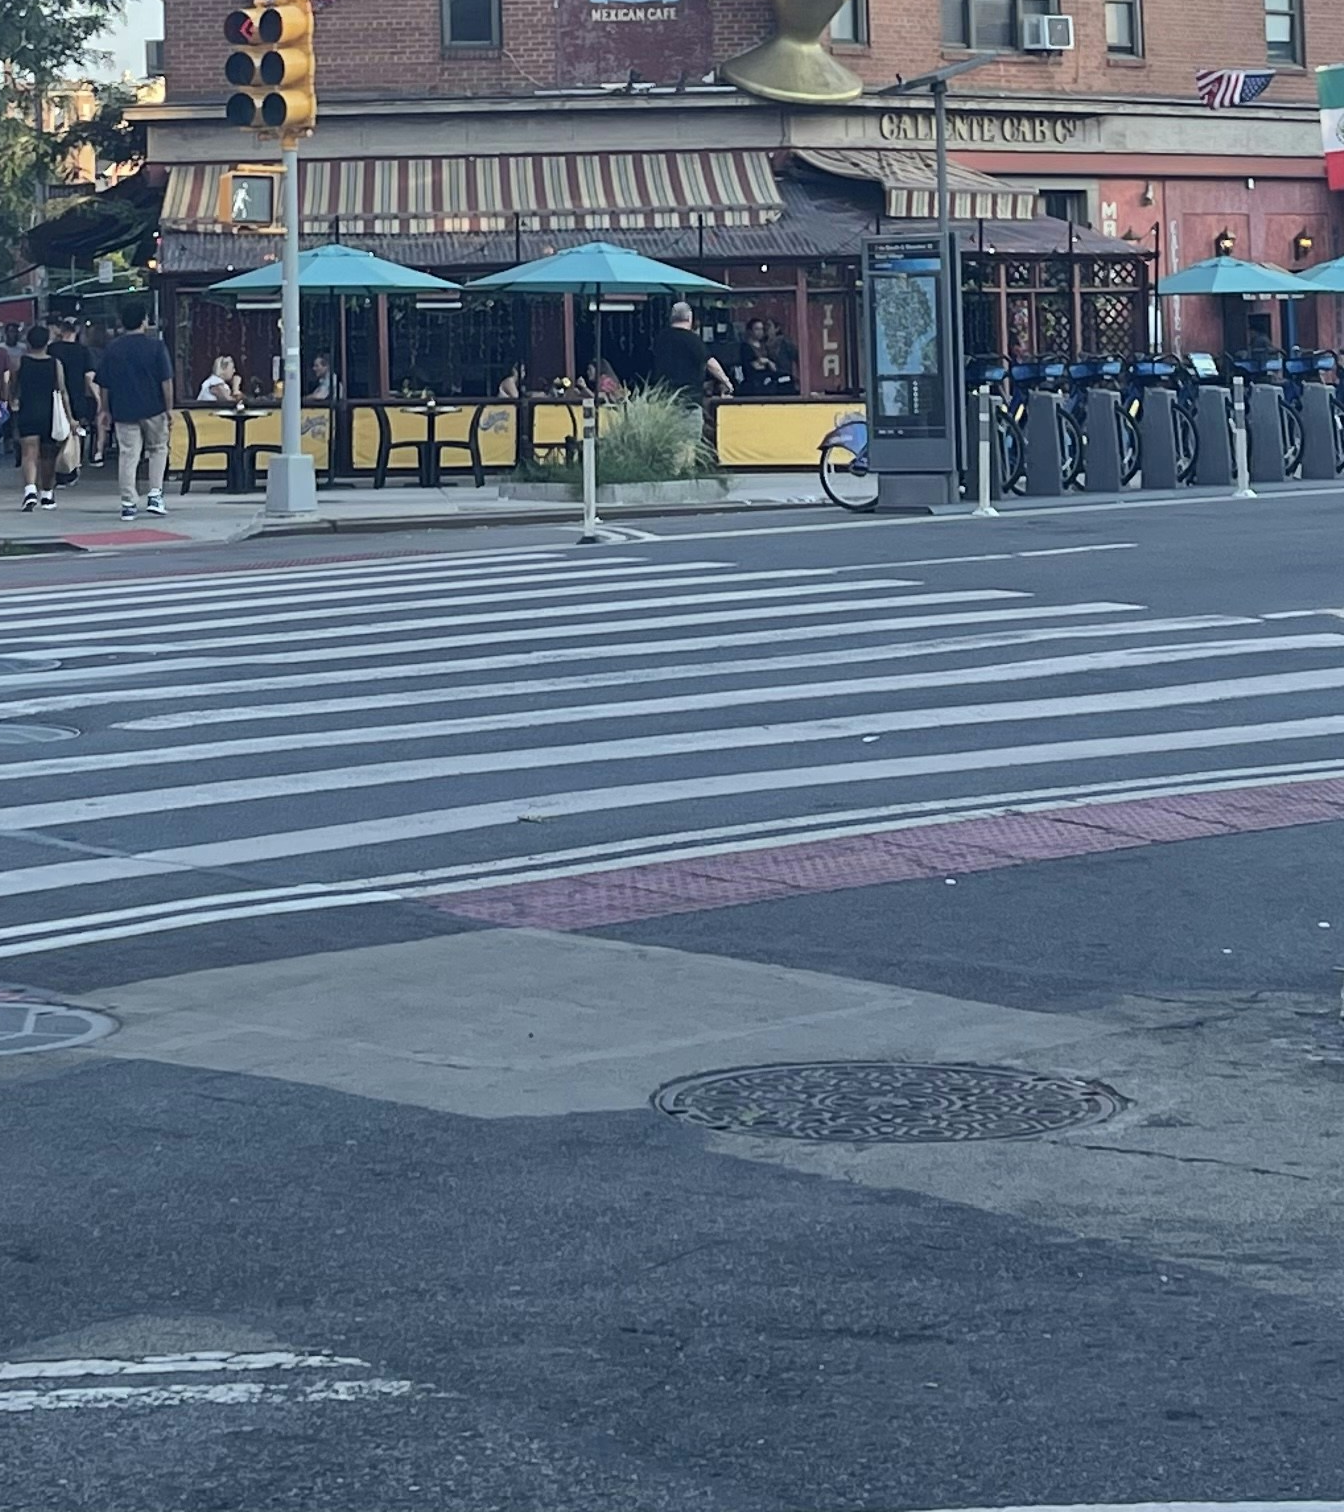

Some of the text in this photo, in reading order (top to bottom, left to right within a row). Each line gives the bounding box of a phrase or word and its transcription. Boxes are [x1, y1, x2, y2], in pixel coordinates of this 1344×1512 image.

[591, 8, 677, 22] MEXICAN CAFE
[1002, 117, 1050, 144] CAB
